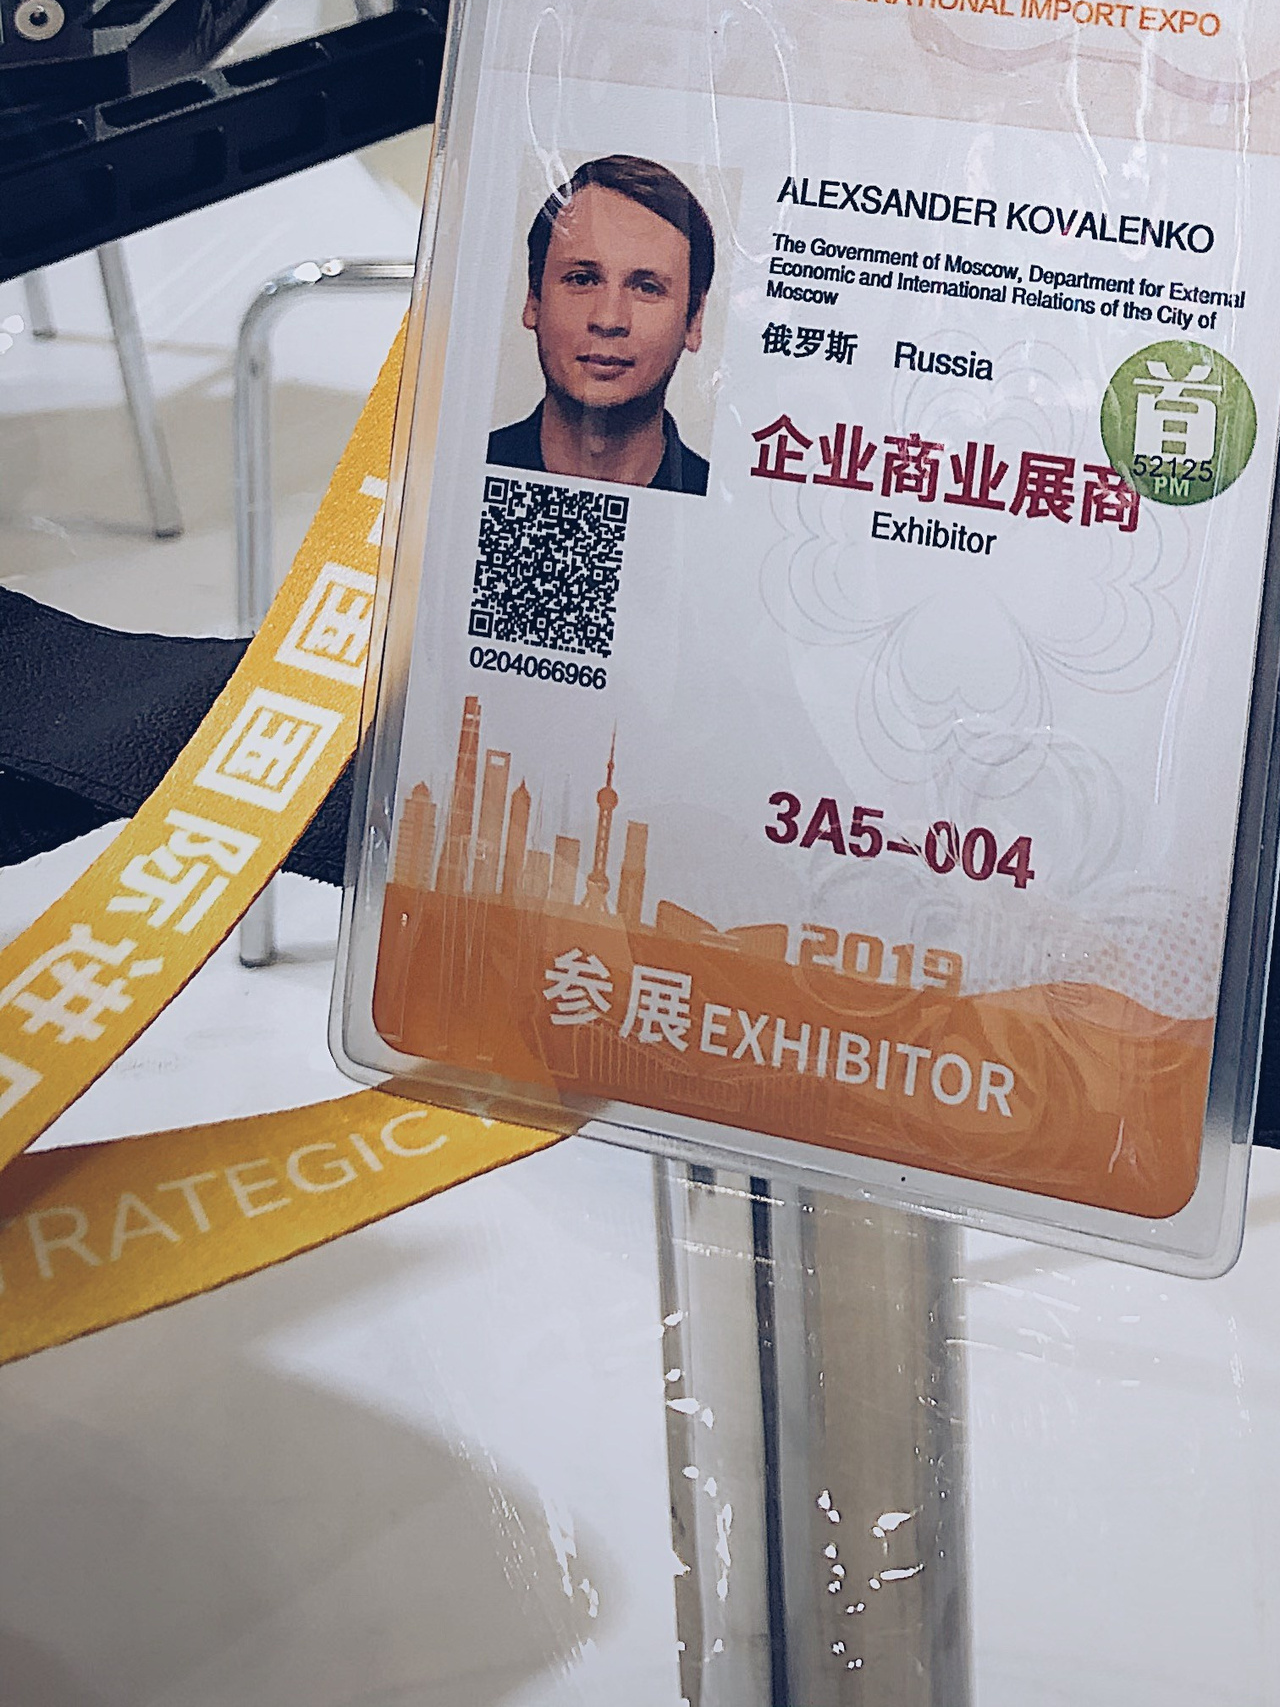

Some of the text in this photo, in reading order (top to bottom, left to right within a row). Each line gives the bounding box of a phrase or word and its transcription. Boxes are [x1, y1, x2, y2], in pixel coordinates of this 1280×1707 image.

[1138, 6, 1222, 38] EXPO
[776, 176, 1215, 254] ALEXSANDER KOVALENKO
[766, 279, 840, 306] Moscow
[769, 256, 1218, 331] Economic and International Relations of the City of
[772, 232, 1246, 309] The Government of Moscow, Department for External
[761, 321, 859, 366] 俄罗斯
[894, 341, 994, 381] Russia
[750, 414, 1141, 533] 企业商业展商
[1132, 454, 1214, 483] 52125
[1154, 476, 1191, 497] PM
[871, 511, 997, 555] Exhibitor
[469, 646, 607, 689] 0204066966
[764, 791, 1035, 889] 3A5-004
[800, 923, 963, 993] 2019
[543, 947, 1016, 1118] 参展 EXHIBITOR
[0, 1110, 448, 1292] RATEGIC
